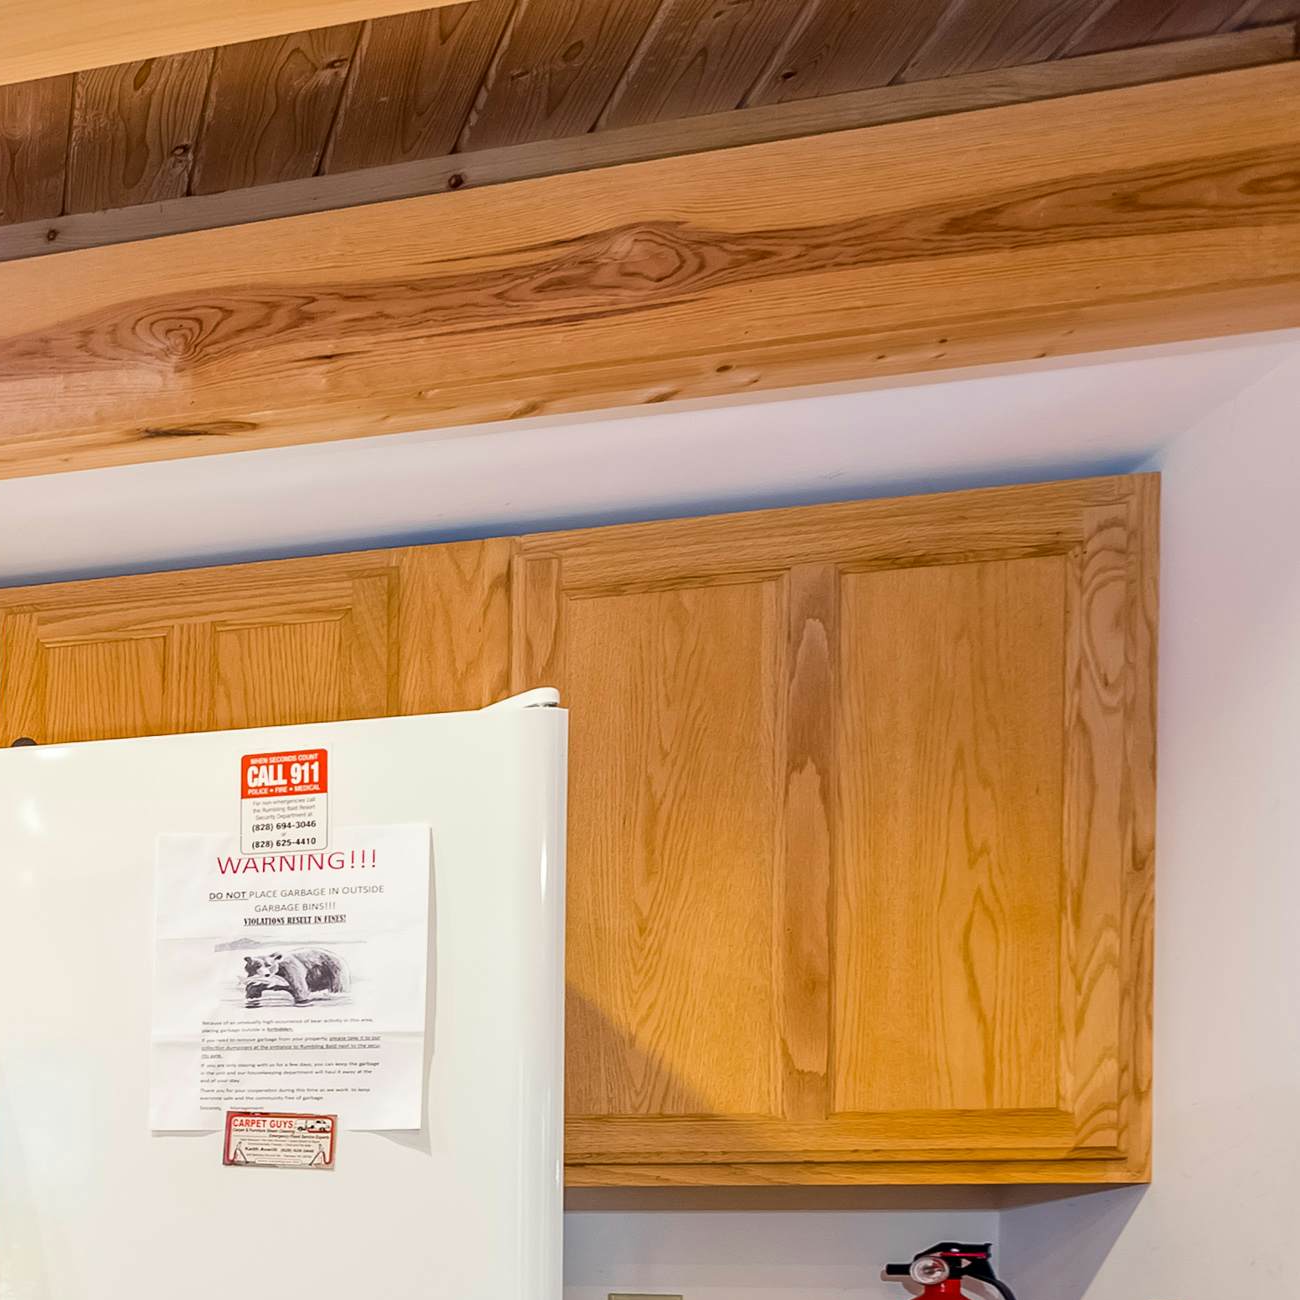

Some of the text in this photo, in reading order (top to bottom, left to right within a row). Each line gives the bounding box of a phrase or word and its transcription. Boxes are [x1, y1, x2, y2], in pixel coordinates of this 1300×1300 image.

[247, 760, 319, 788] CALL 911
[247, 783, 320, 795] POLICE FIRE MEDICAL
[251, 820, 317, 833] (828) 694-3046
[251, 837, 317, 850] (828) 625-4410
[217, 849, 376, 875] WARNING!!!
[209, 885, 385, 900] DO NOT PLACE GARBAGE IN OUTSIDE
[254, 901, 336, 913] GARBAGE BINS!!!
[243, 914, 347, 926] VIOLATIONS RESULT IN FINES!
[232, 1119, 294, 1128] CARPET GUYS
